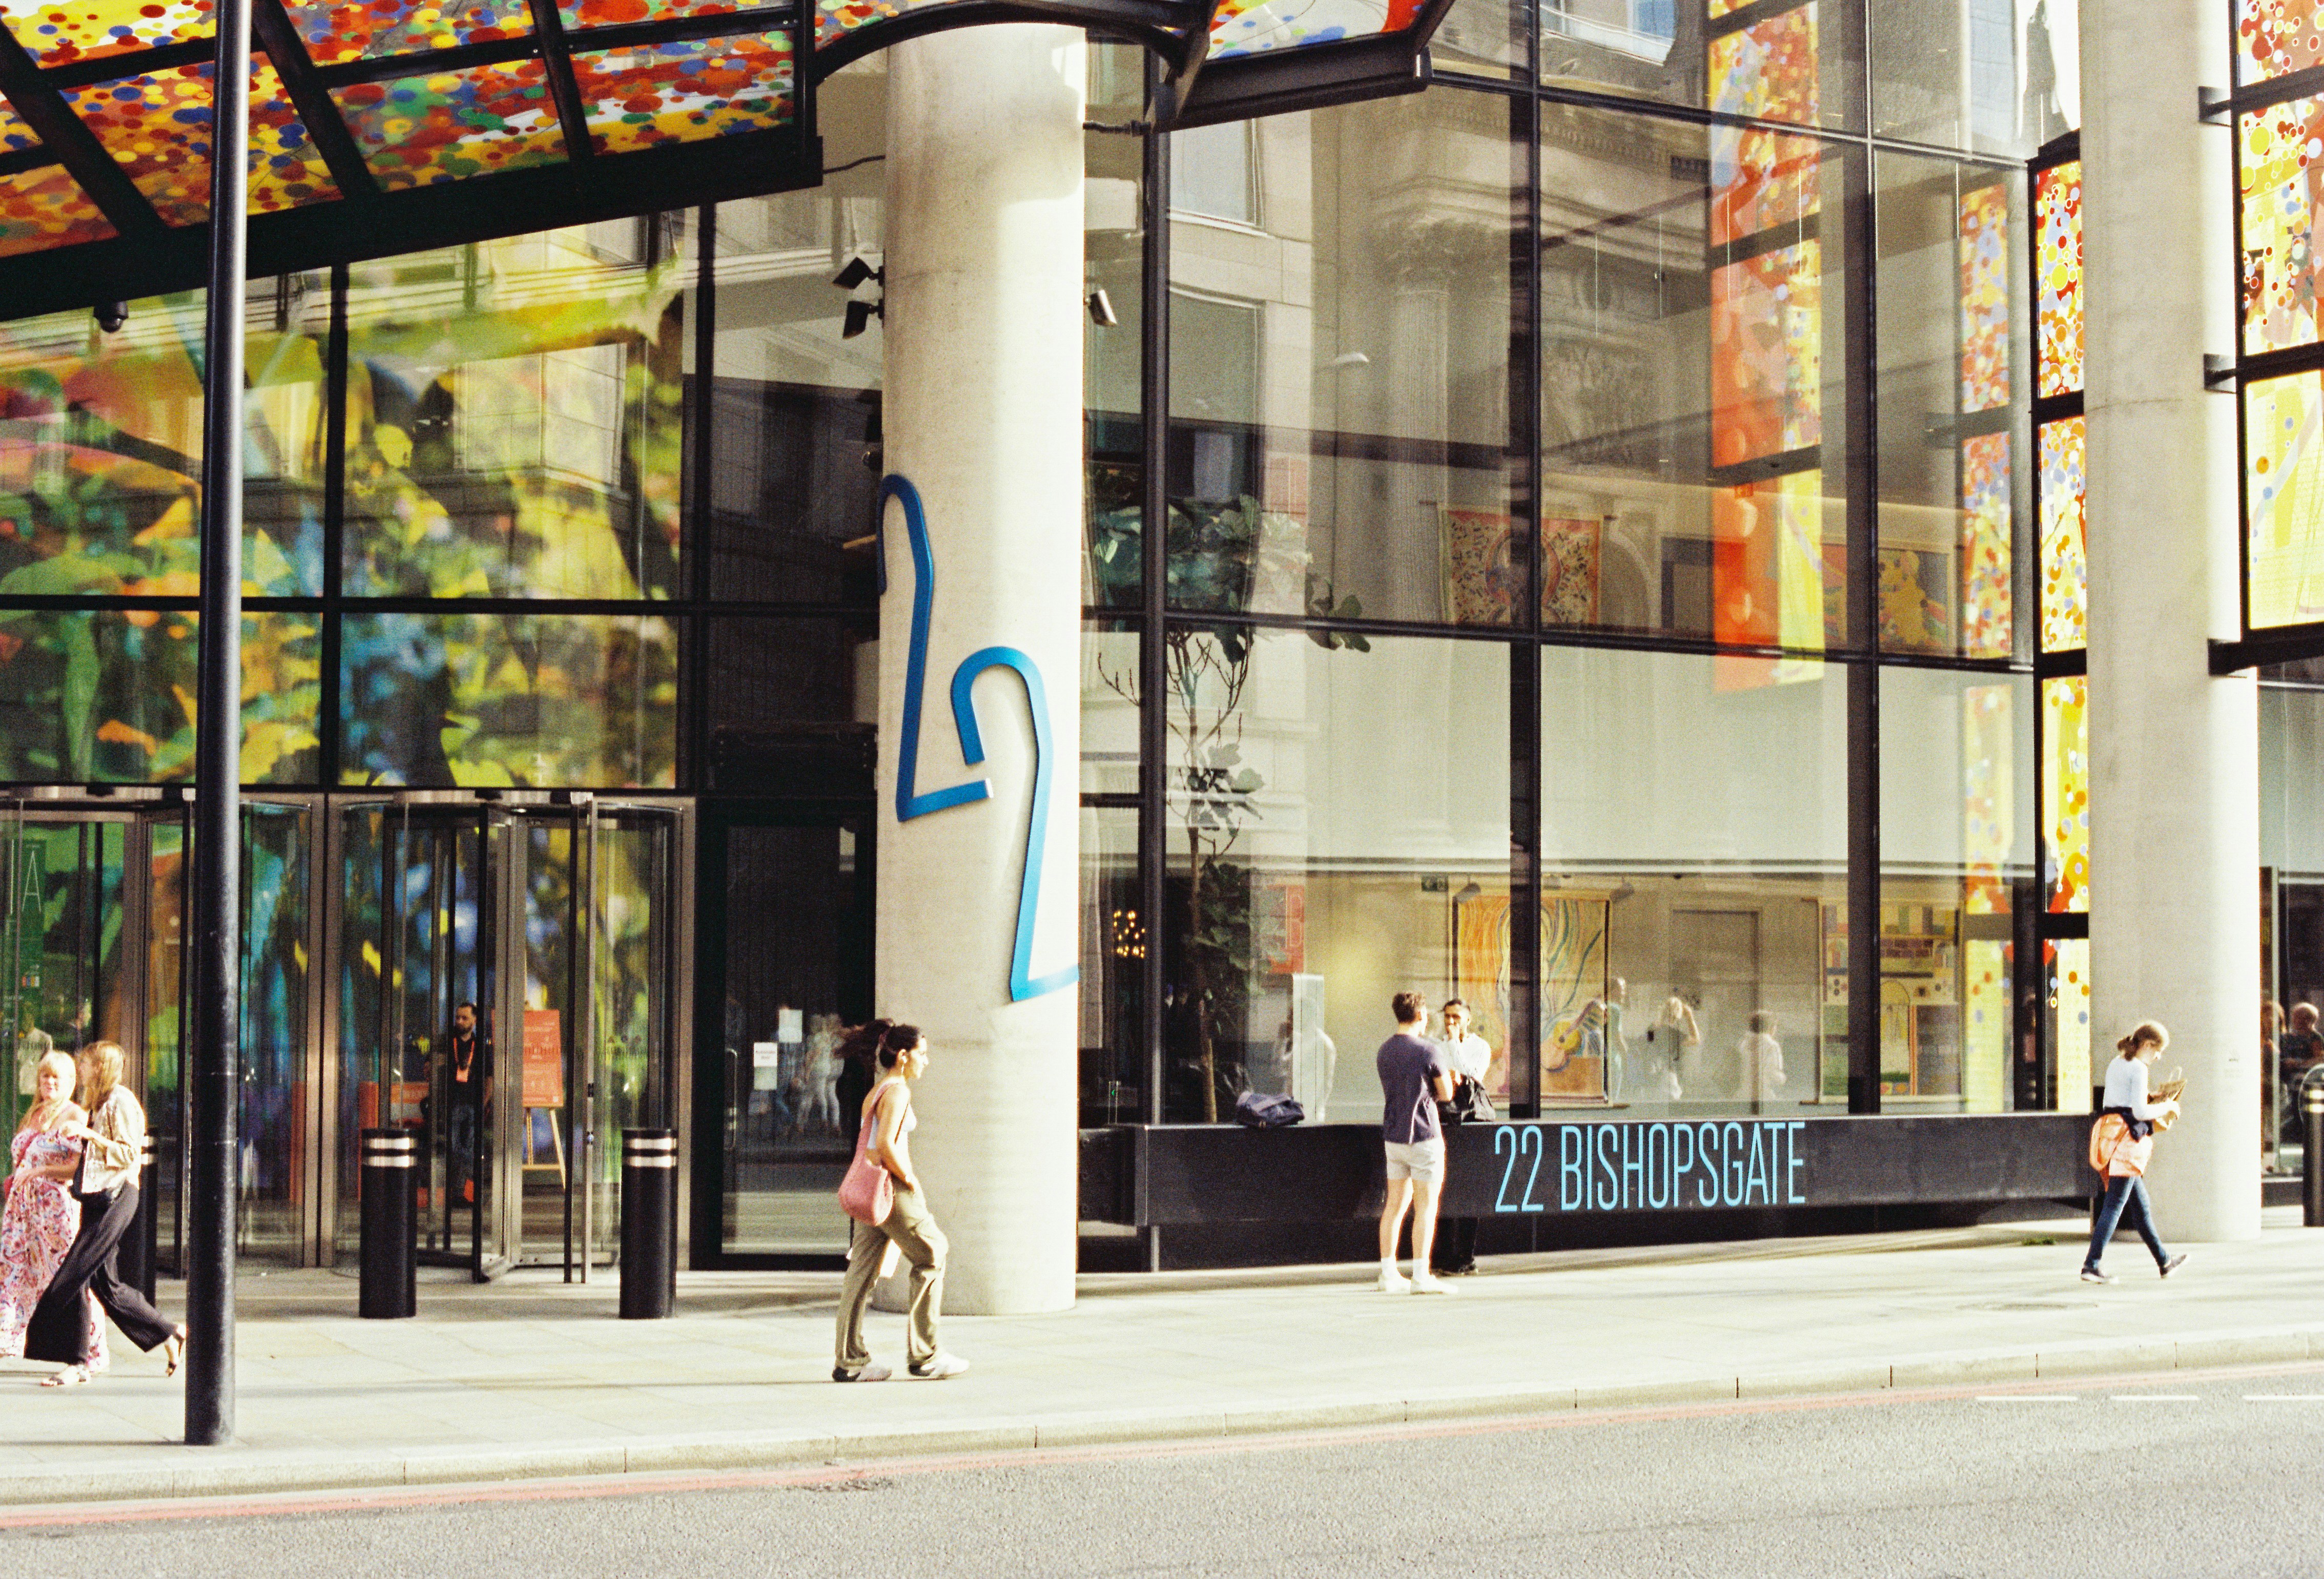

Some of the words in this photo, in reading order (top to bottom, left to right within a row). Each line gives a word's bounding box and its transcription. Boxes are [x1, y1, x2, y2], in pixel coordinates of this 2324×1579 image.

[876, 474, 1080, 1002] 22
[1495, 1126, 1544, 1213] 22
[1561, 1122, 1805, 1211] BISHOPSGATE
